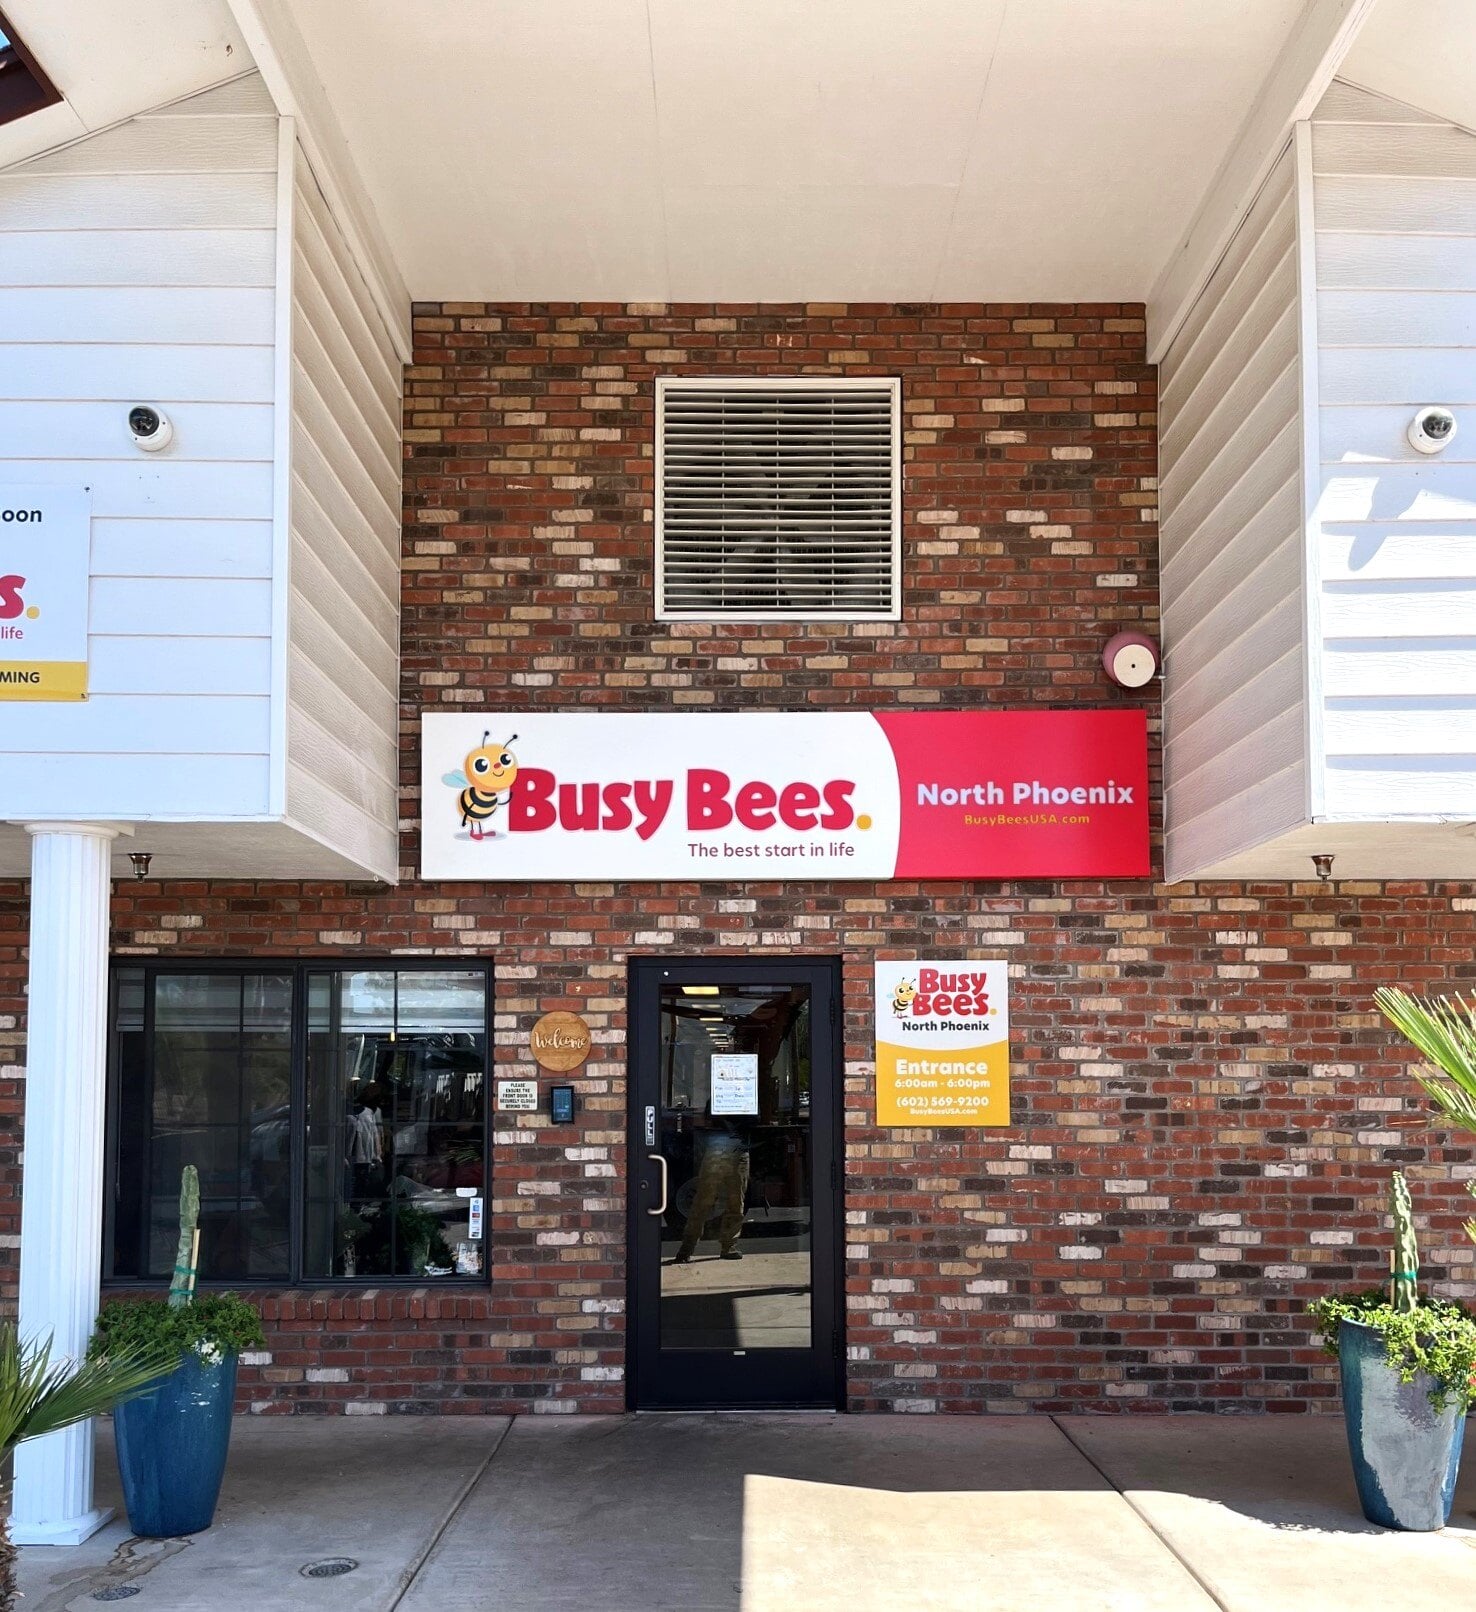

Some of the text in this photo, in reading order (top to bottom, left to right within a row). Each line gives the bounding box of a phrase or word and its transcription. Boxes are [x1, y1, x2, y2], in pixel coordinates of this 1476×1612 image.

[1, 509, 43, 523] oon
[1, 626, 24, 640] life
[917, 779, 1134, 806] North Phoenix
[508, 767, 872, 841] Busy Bees.
[964, 814, 1090, 827] BusyBeesUSA.com
[687, 842, 855, 857] The best start in life
[919, 968, 987, 996] Busy
[912, 993, 997, 1016] Bees.
[902, 1020, 989, 1032] North Phoenix
[534, 1028, 587, 1049] Welcome
[895, 1058, 988, 1075] Entrance
[894, 1078, 938, 1088] 6:00am
[946, 1078, 991, 1090] 6:00pm
[896, 1096, 989, 1108] (602) 569-9200
